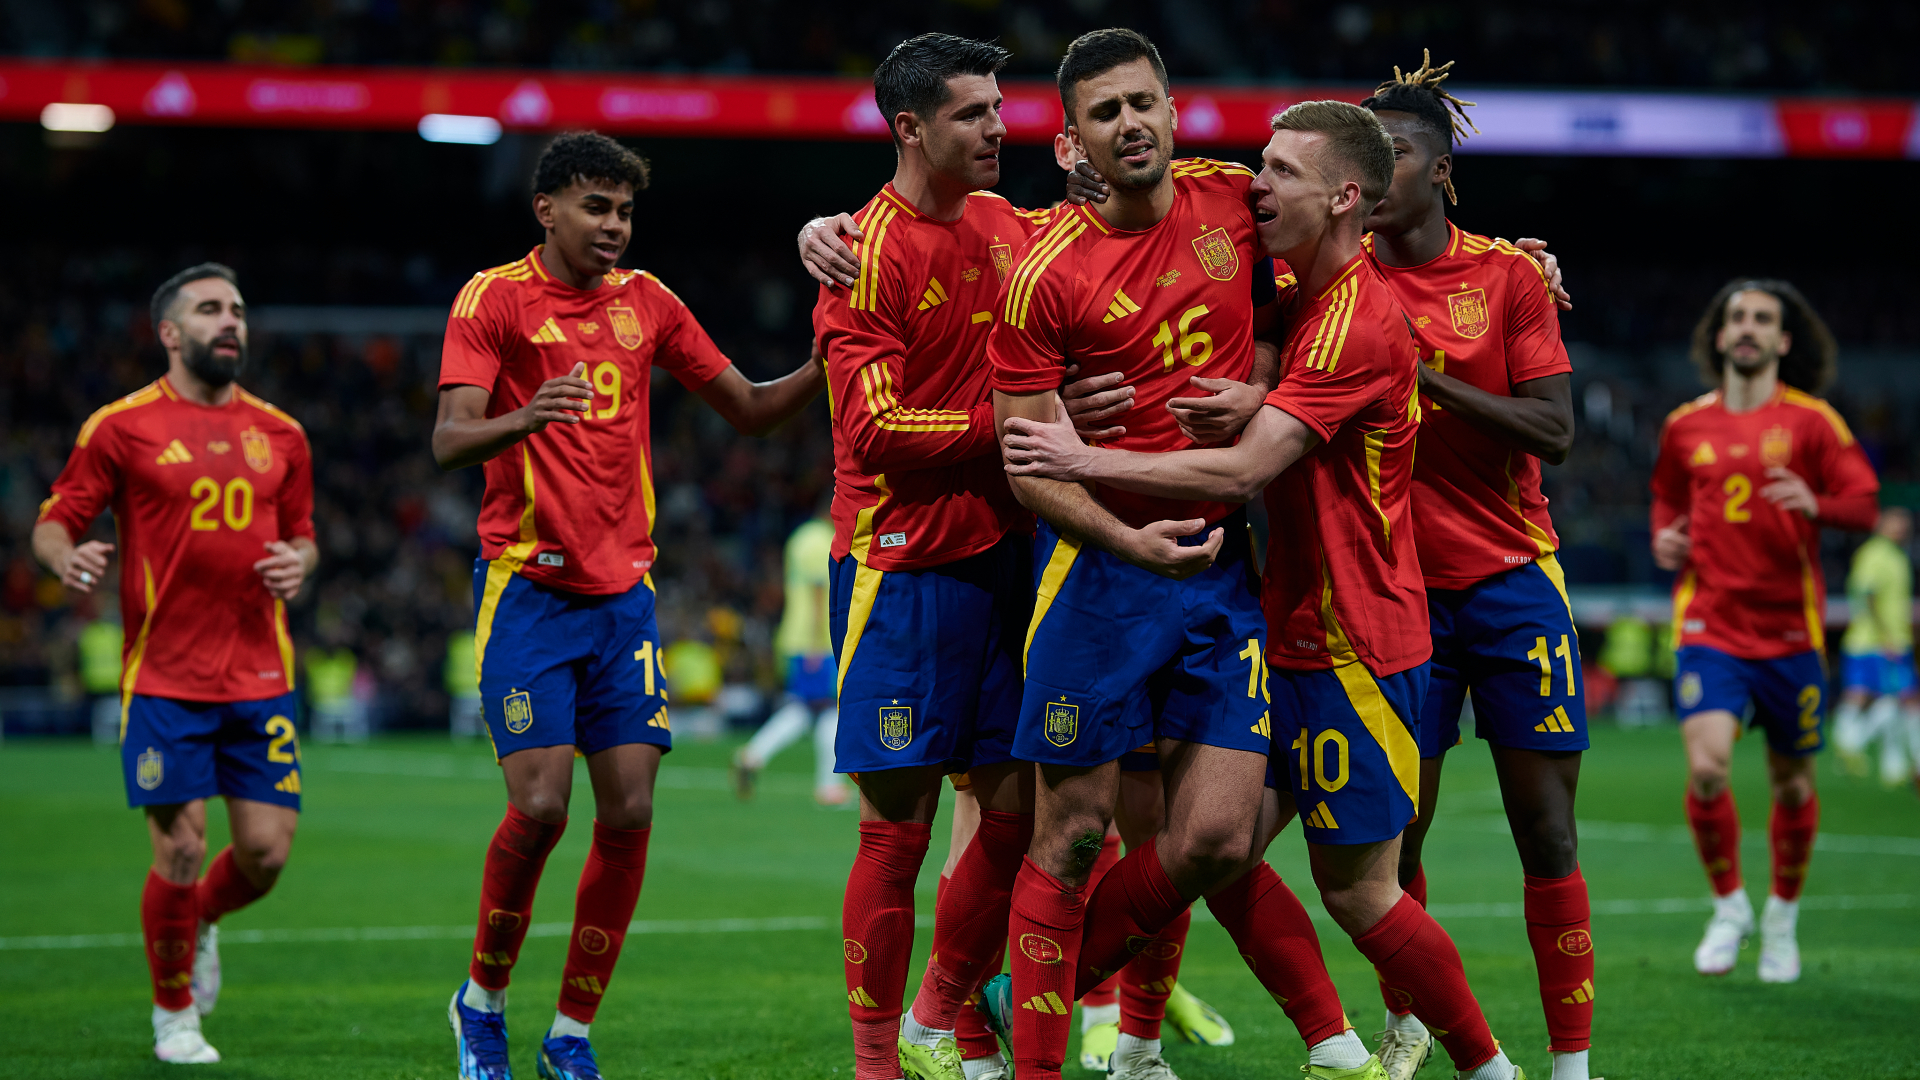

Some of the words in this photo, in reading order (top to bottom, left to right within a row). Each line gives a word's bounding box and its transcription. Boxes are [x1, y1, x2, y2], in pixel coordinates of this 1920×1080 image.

[1152, 304, 1213, 373] 16
[190, 476, 254, 532] 20
[1724, 473, 1752, 523] 2
[1504, 556, 1531, 564] HEAT.RDY
[1527, 634, 1576, 696] 11
[1797, 684, 1821, 731] 2
[1292, 727, 1350, 793] 10
